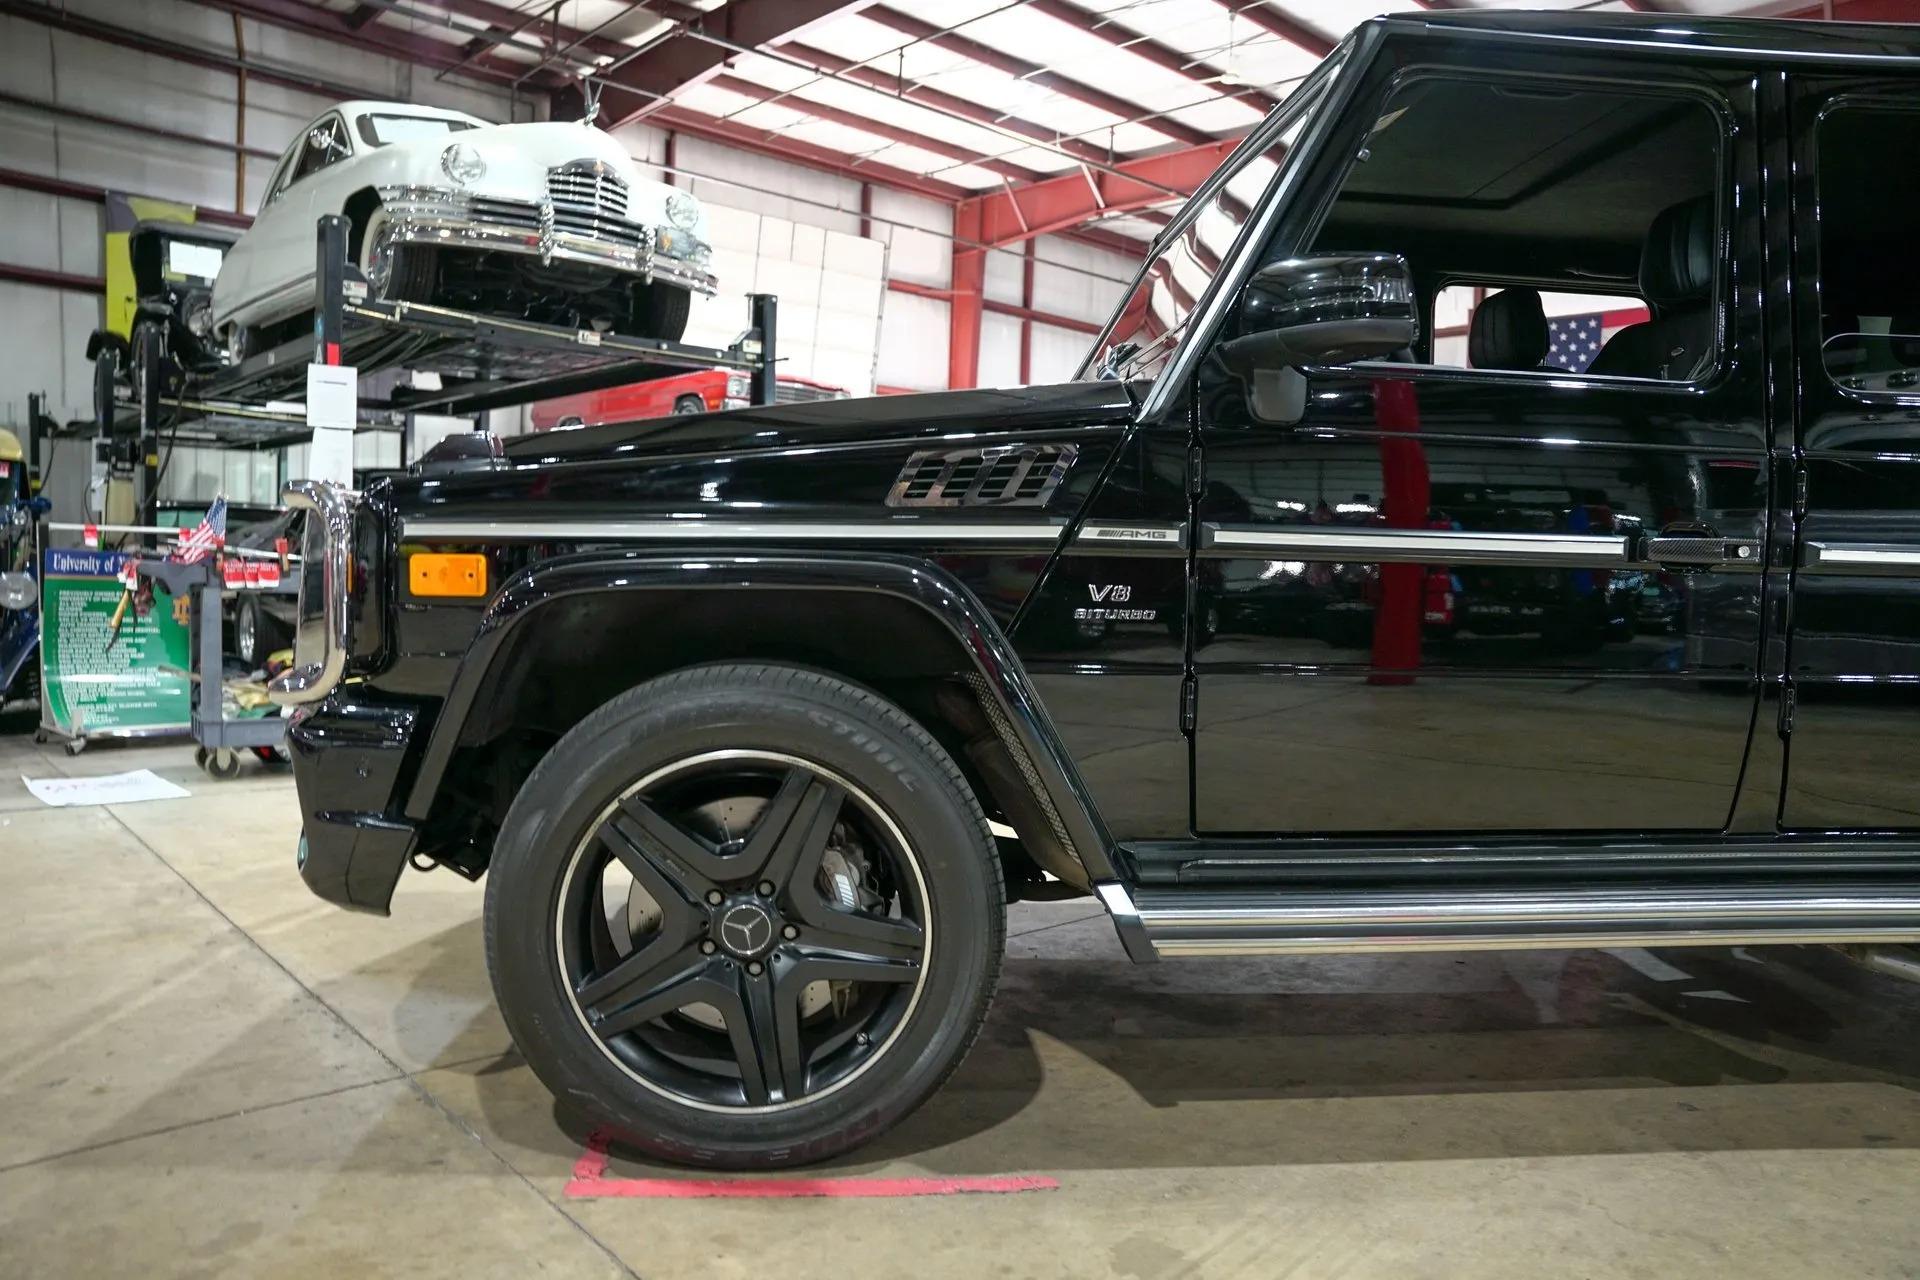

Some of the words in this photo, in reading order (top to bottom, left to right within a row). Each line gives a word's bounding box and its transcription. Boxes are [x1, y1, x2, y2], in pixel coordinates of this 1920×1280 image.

[1118, 530, 1167, 540] AMG
[53, 552, 101, 575] University
[104, 555, 115, 573] of
[1088, 583, 1132, 602] V8
[1073, 608, 1156, 620] BITURBO
